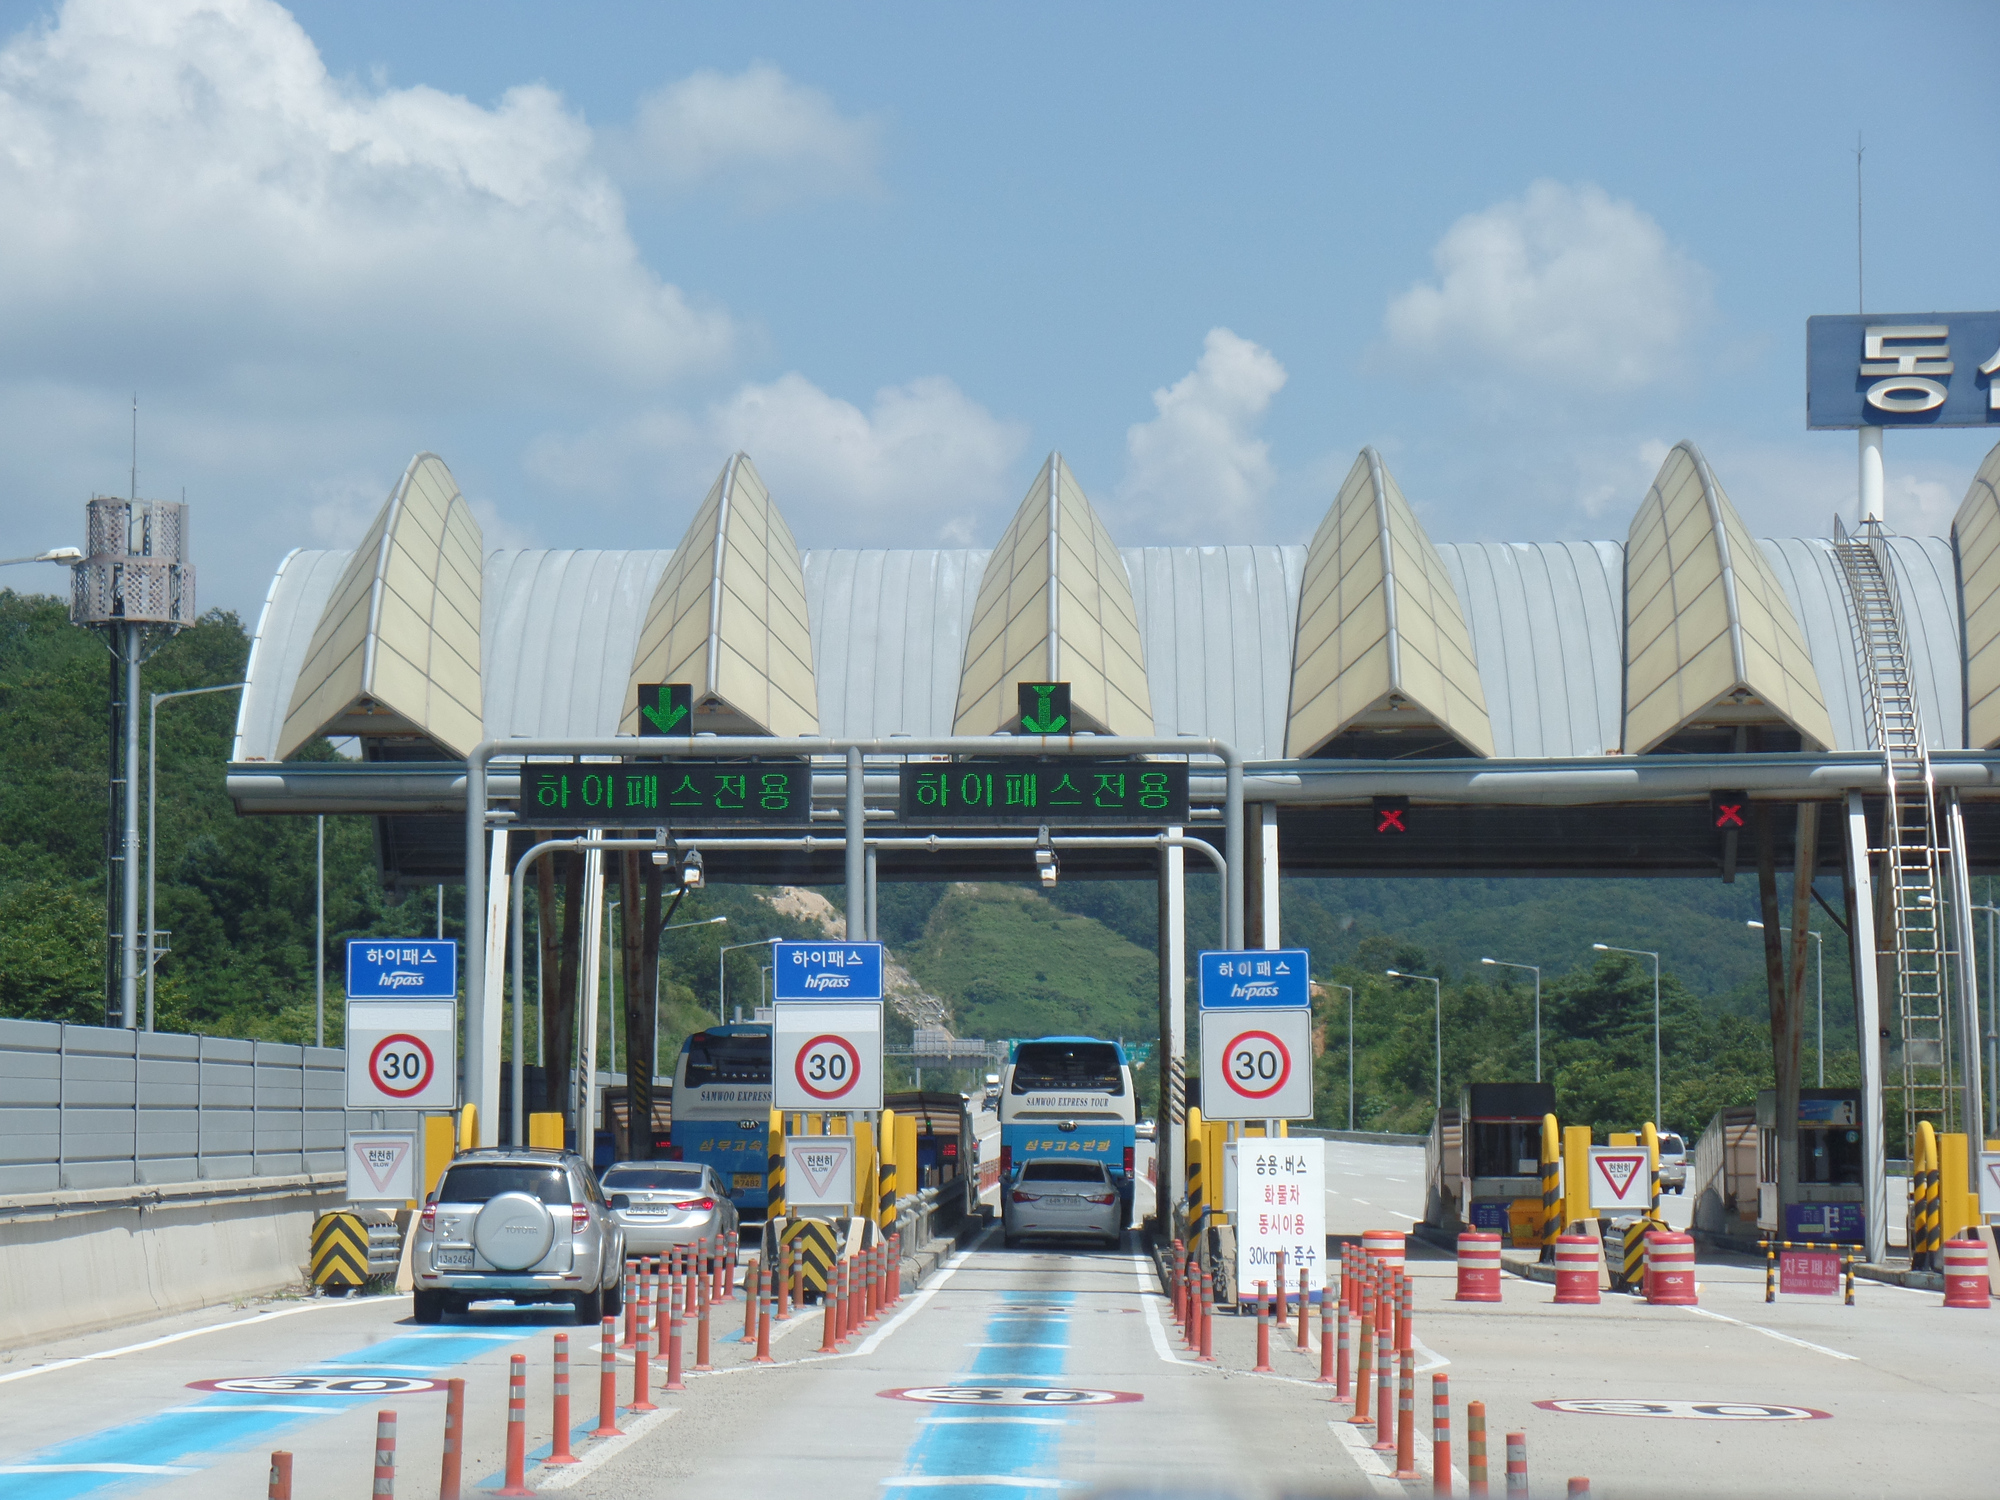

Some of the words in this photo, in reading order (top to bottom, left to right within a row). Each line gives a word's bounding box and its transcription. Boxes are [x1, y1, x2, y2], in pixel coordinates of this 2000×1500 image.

[1860, 324, 2000, 412] 동
[537, 774, 791, 810] 하이패스전용
[916, 773, 1171, 808] 하이패스전용
[366, 948, 437, 965] 하이패스
[792, 951, 863, 968] 하이패스
[1219, 961, 1290, 977] 하이패스
[383, 1053, 420, 1080] 30
[809, 1054, 846, 1081] 30
[1235, 1051, 1277, 1080] 30
[701, 1091, 735, 1102] SAMWOO
[737, 1091, 772, 1102] EXPRESS
[1027, 1097, 1056, 1107] SAMWOO
[1058, 1097, 1088, 1107] EXPRESS
[1091, 1098, 1109, 1107] TOUR
[740, 1120, 756, 1129] KIA
[700, 1138, 768, 1152] 삼우고속
[368, 1150, 394, 1162] 천천히
[807, 1155, 833, 1167] 천천히
[1609, 1163, 1630, 1173] 천천히
[1264, 1184, 1300, 1205] 화물차
[505, 1226, 538, 1235] TOYOTA
[1258, 1214, 1305, 1235] 동시이용
[1294, 1245, 1316, 1266] 준수
[1783, 1258, 1837, 1276] 차로폐쇄
